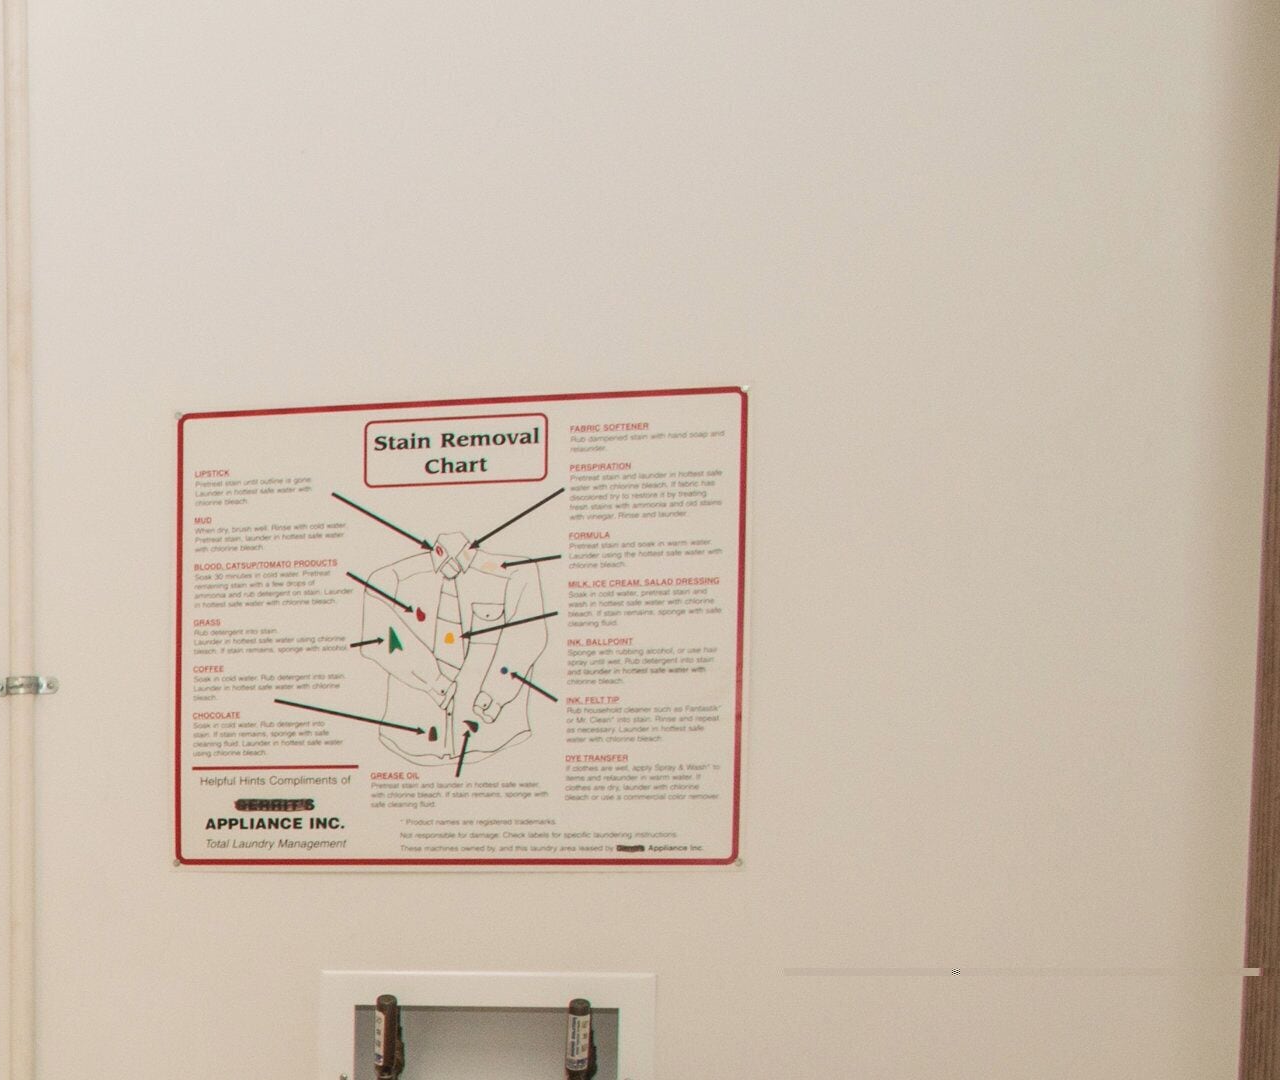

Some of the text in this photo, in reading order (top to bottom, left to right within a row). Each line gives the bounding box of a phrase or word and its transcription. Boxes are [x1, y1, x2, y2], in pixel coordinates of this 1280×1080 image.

[603, 422, 649, 432] SOFTENER
[374, 428, 538, 451] Stain Removal
[425, 458, 486, 474] Chart
[569, 462, 632, 472] PERSPIRATION
[194, 469, 230, 479] LIPSTICK
[293, 558, 338, 568] PRODUCTS
[675, 576, 720, 586] DRESSING
[585, 637, 633, 647] BALLPOINT
[199, 774, 352, 788] Helpful Hints Compliments of
[205, 817, 344, 830] APPLIANCE INC.
[206, 838, 348, 851] Total Laundry Management
